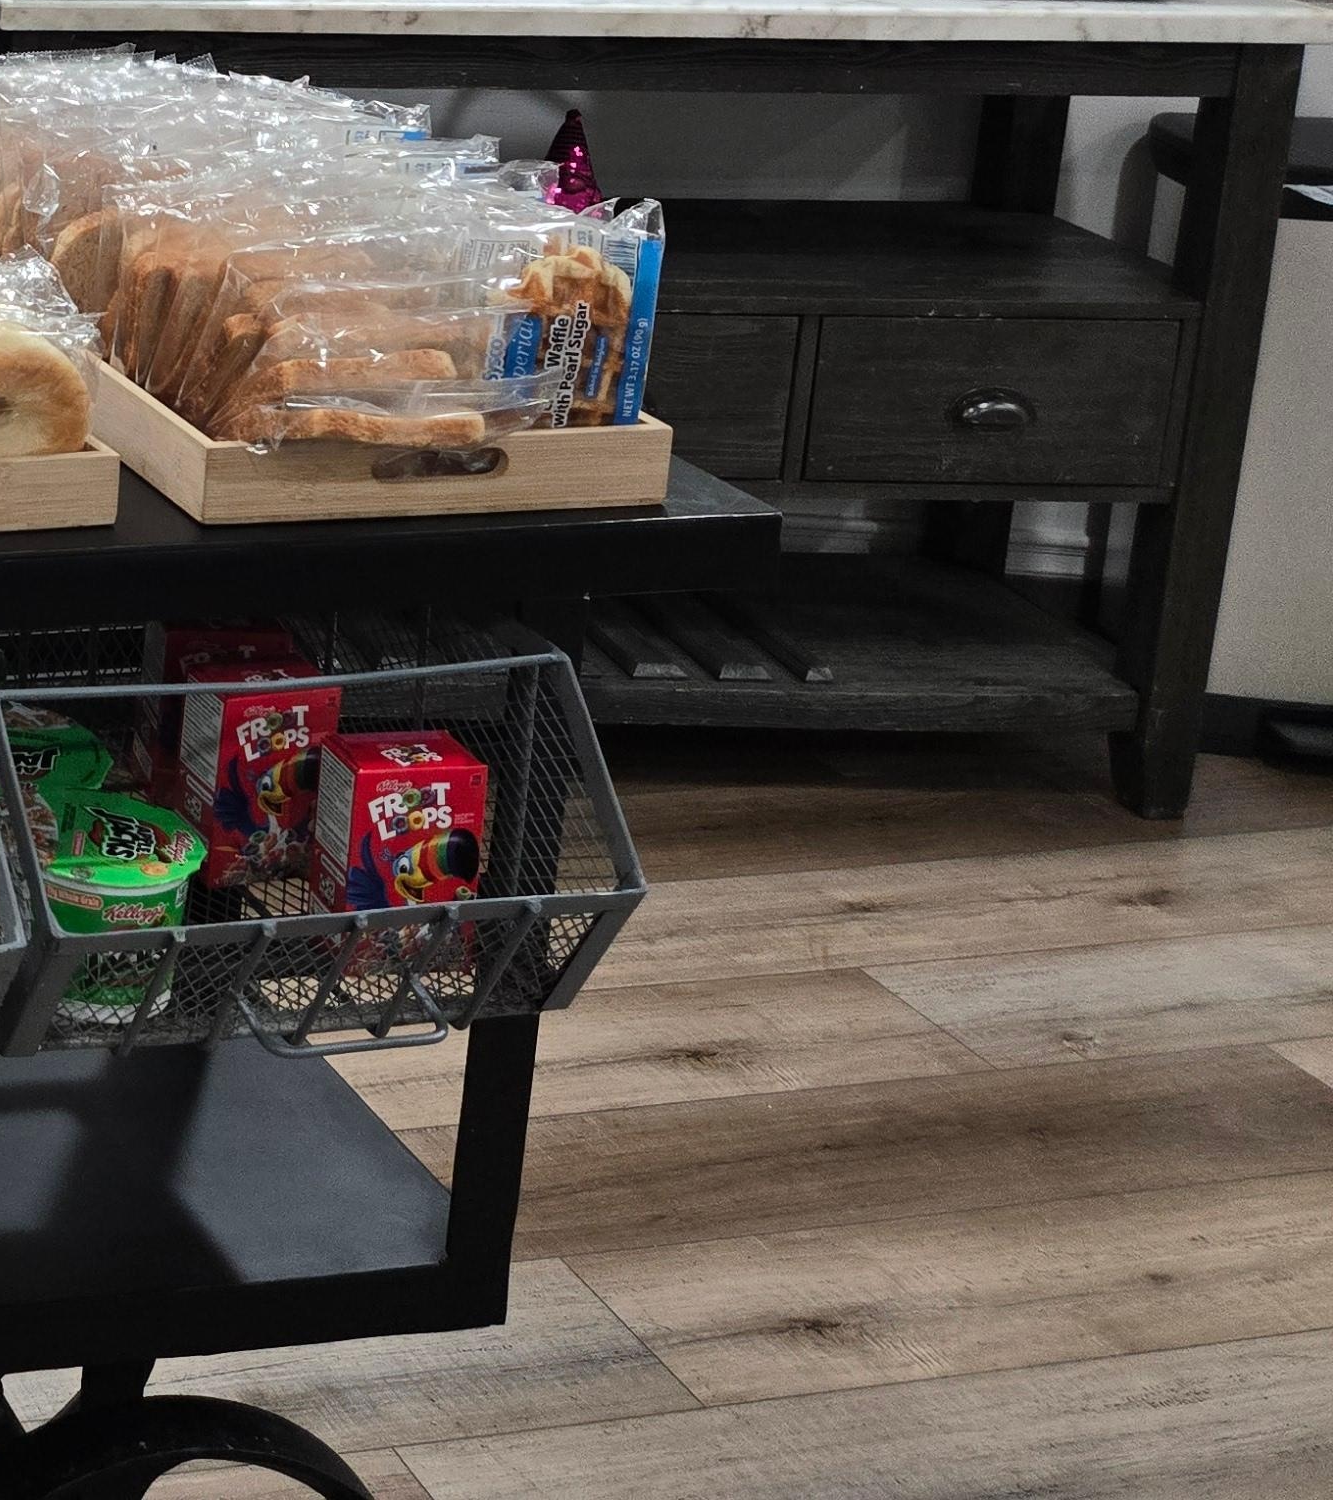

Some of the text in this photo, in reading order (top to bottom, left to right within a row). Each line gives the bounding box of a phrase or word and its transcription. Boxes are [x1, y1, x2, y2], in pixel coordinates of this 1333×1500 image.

[511, 315, 535, 378] perial
[546, 317, 570, 368] Waffle
[632, 346, 642, 359] OZ
[553, 302, 589, 427] with Pearl Sugar
[628, 359, 640, 381] 3.17
[622, 399, 633, 417] NET
[625, 382, 635, 398] WT
[236, 705, 309, 747] FROOT
[243, 726, 310, 763] LOOPS
[367, 782, 451, 824] FROOT
[375, 779, 413, 793] Kellogg's
[376, 805, 453, 841] LOOPS
[102, 902, 166, 925] Kellogg's
